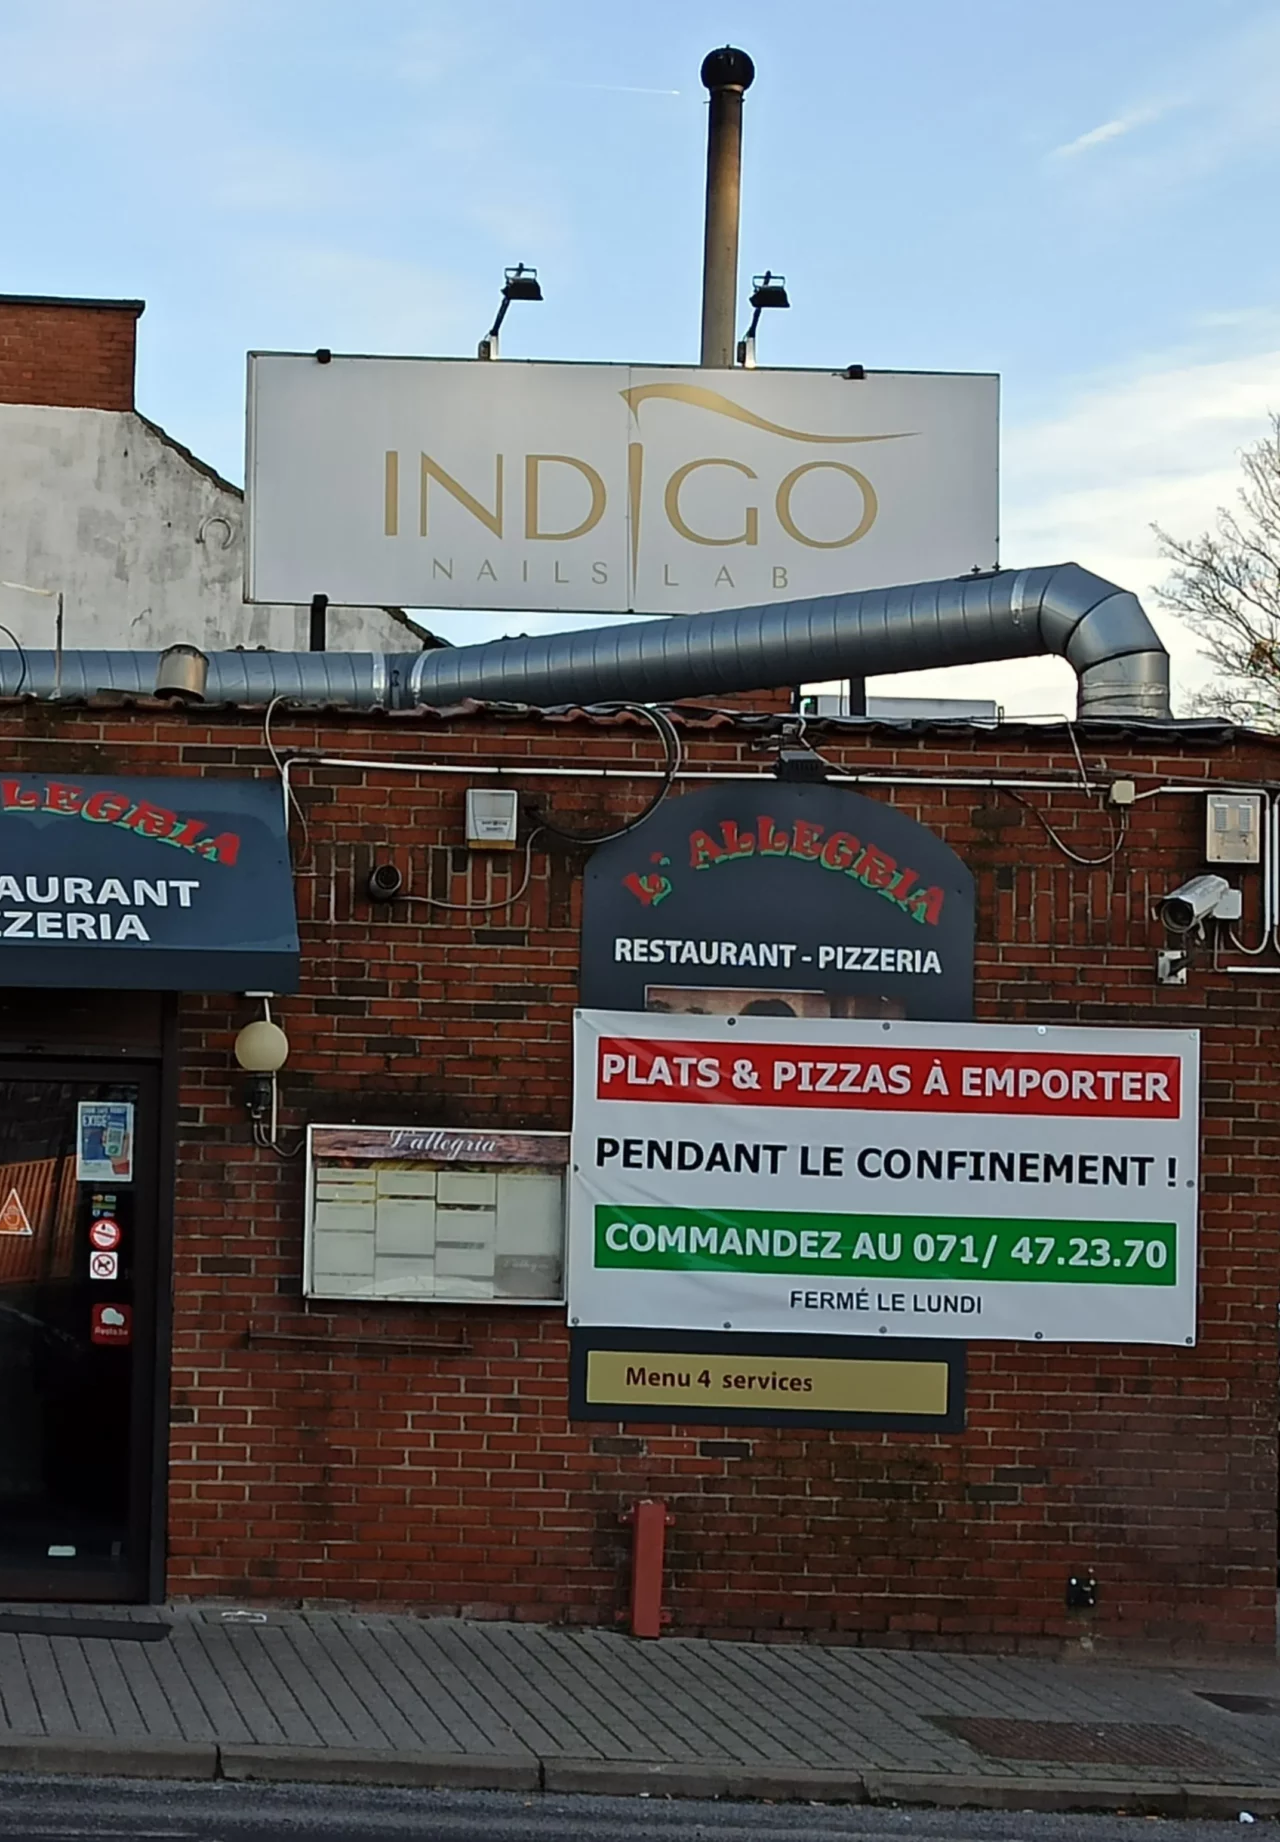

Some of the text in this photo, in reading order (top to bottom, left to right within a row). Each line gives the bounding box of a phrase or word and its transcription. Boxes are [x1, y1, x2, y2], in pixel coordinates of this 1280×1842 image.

[384, 442, 879, 594] INDIGO
[431, 556, 790, 590] NAILS LAB
[614, 937, 797, 969] RESTAURANT
[818, 945, 943, 974] PIZZERIA
[600, 1053, 1173, 1103] PLATS & PIZZAS À EMPORTER
[595, 1136, 1179, 1189] PENDANT LE CONFINEMENT !
[603, 1222, 1169, 1270] COMMANDEZ AU 071/ 47.23.70
[789, 1285, 983, 1316] FERMÉ LE LUNDI
[625, 1366, 814, 1394] Menu 4 services
